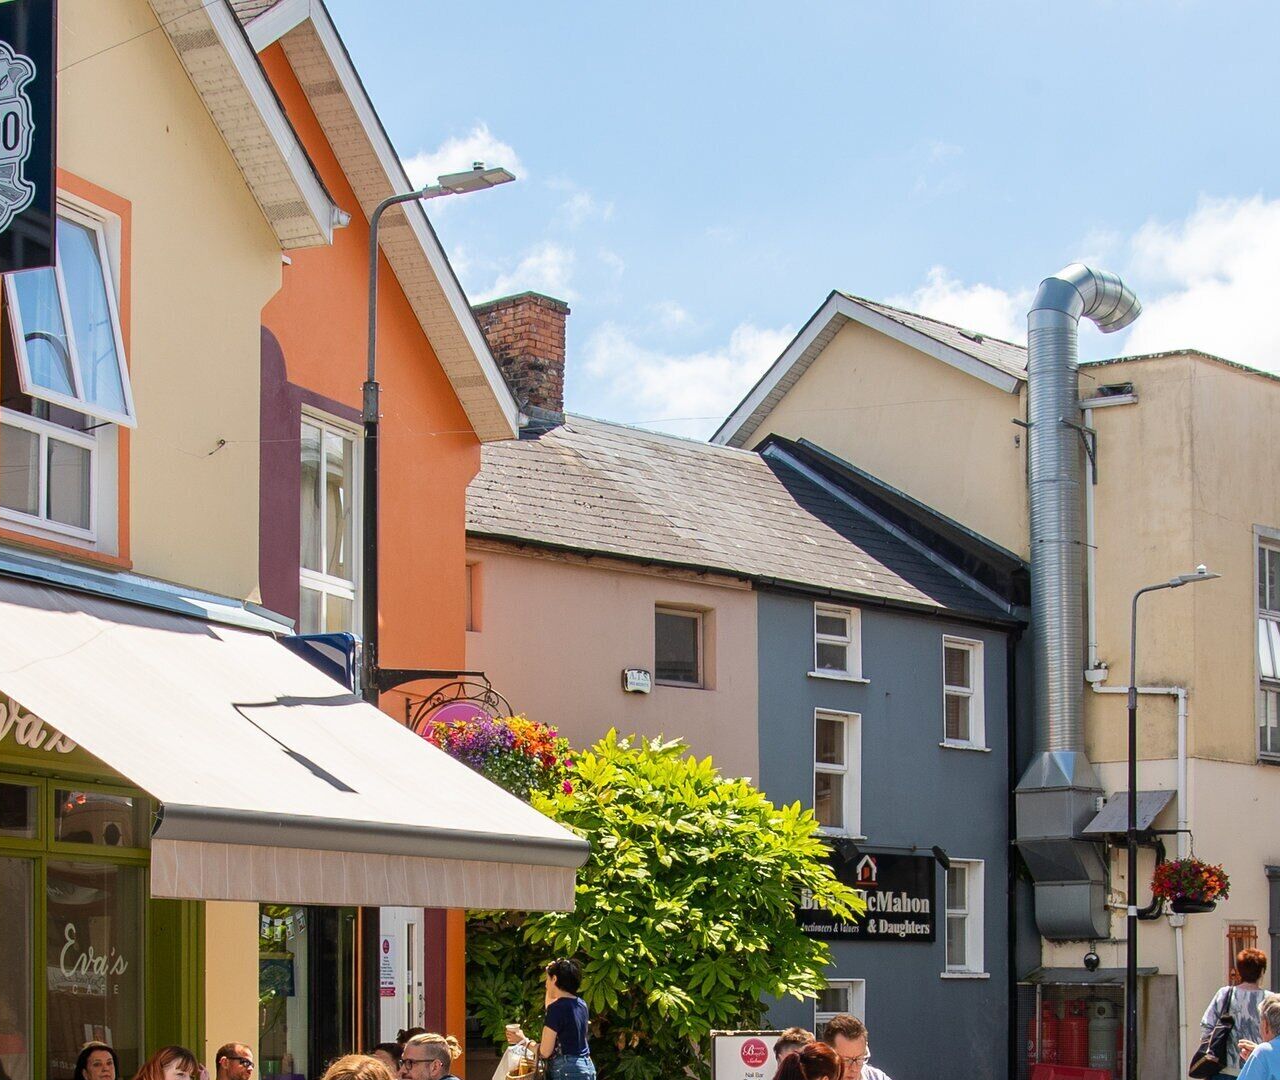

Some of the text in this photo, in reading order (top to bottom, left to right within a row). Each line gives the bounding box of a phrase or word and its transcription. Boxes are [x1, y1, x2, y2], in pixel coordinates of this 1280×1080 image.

[867, 918, 877, 934] &
[879, 918, 930, 938] Daughters
[60, 922, 128, 977] Eva's
[72, 984, 119, 994] CAFE
